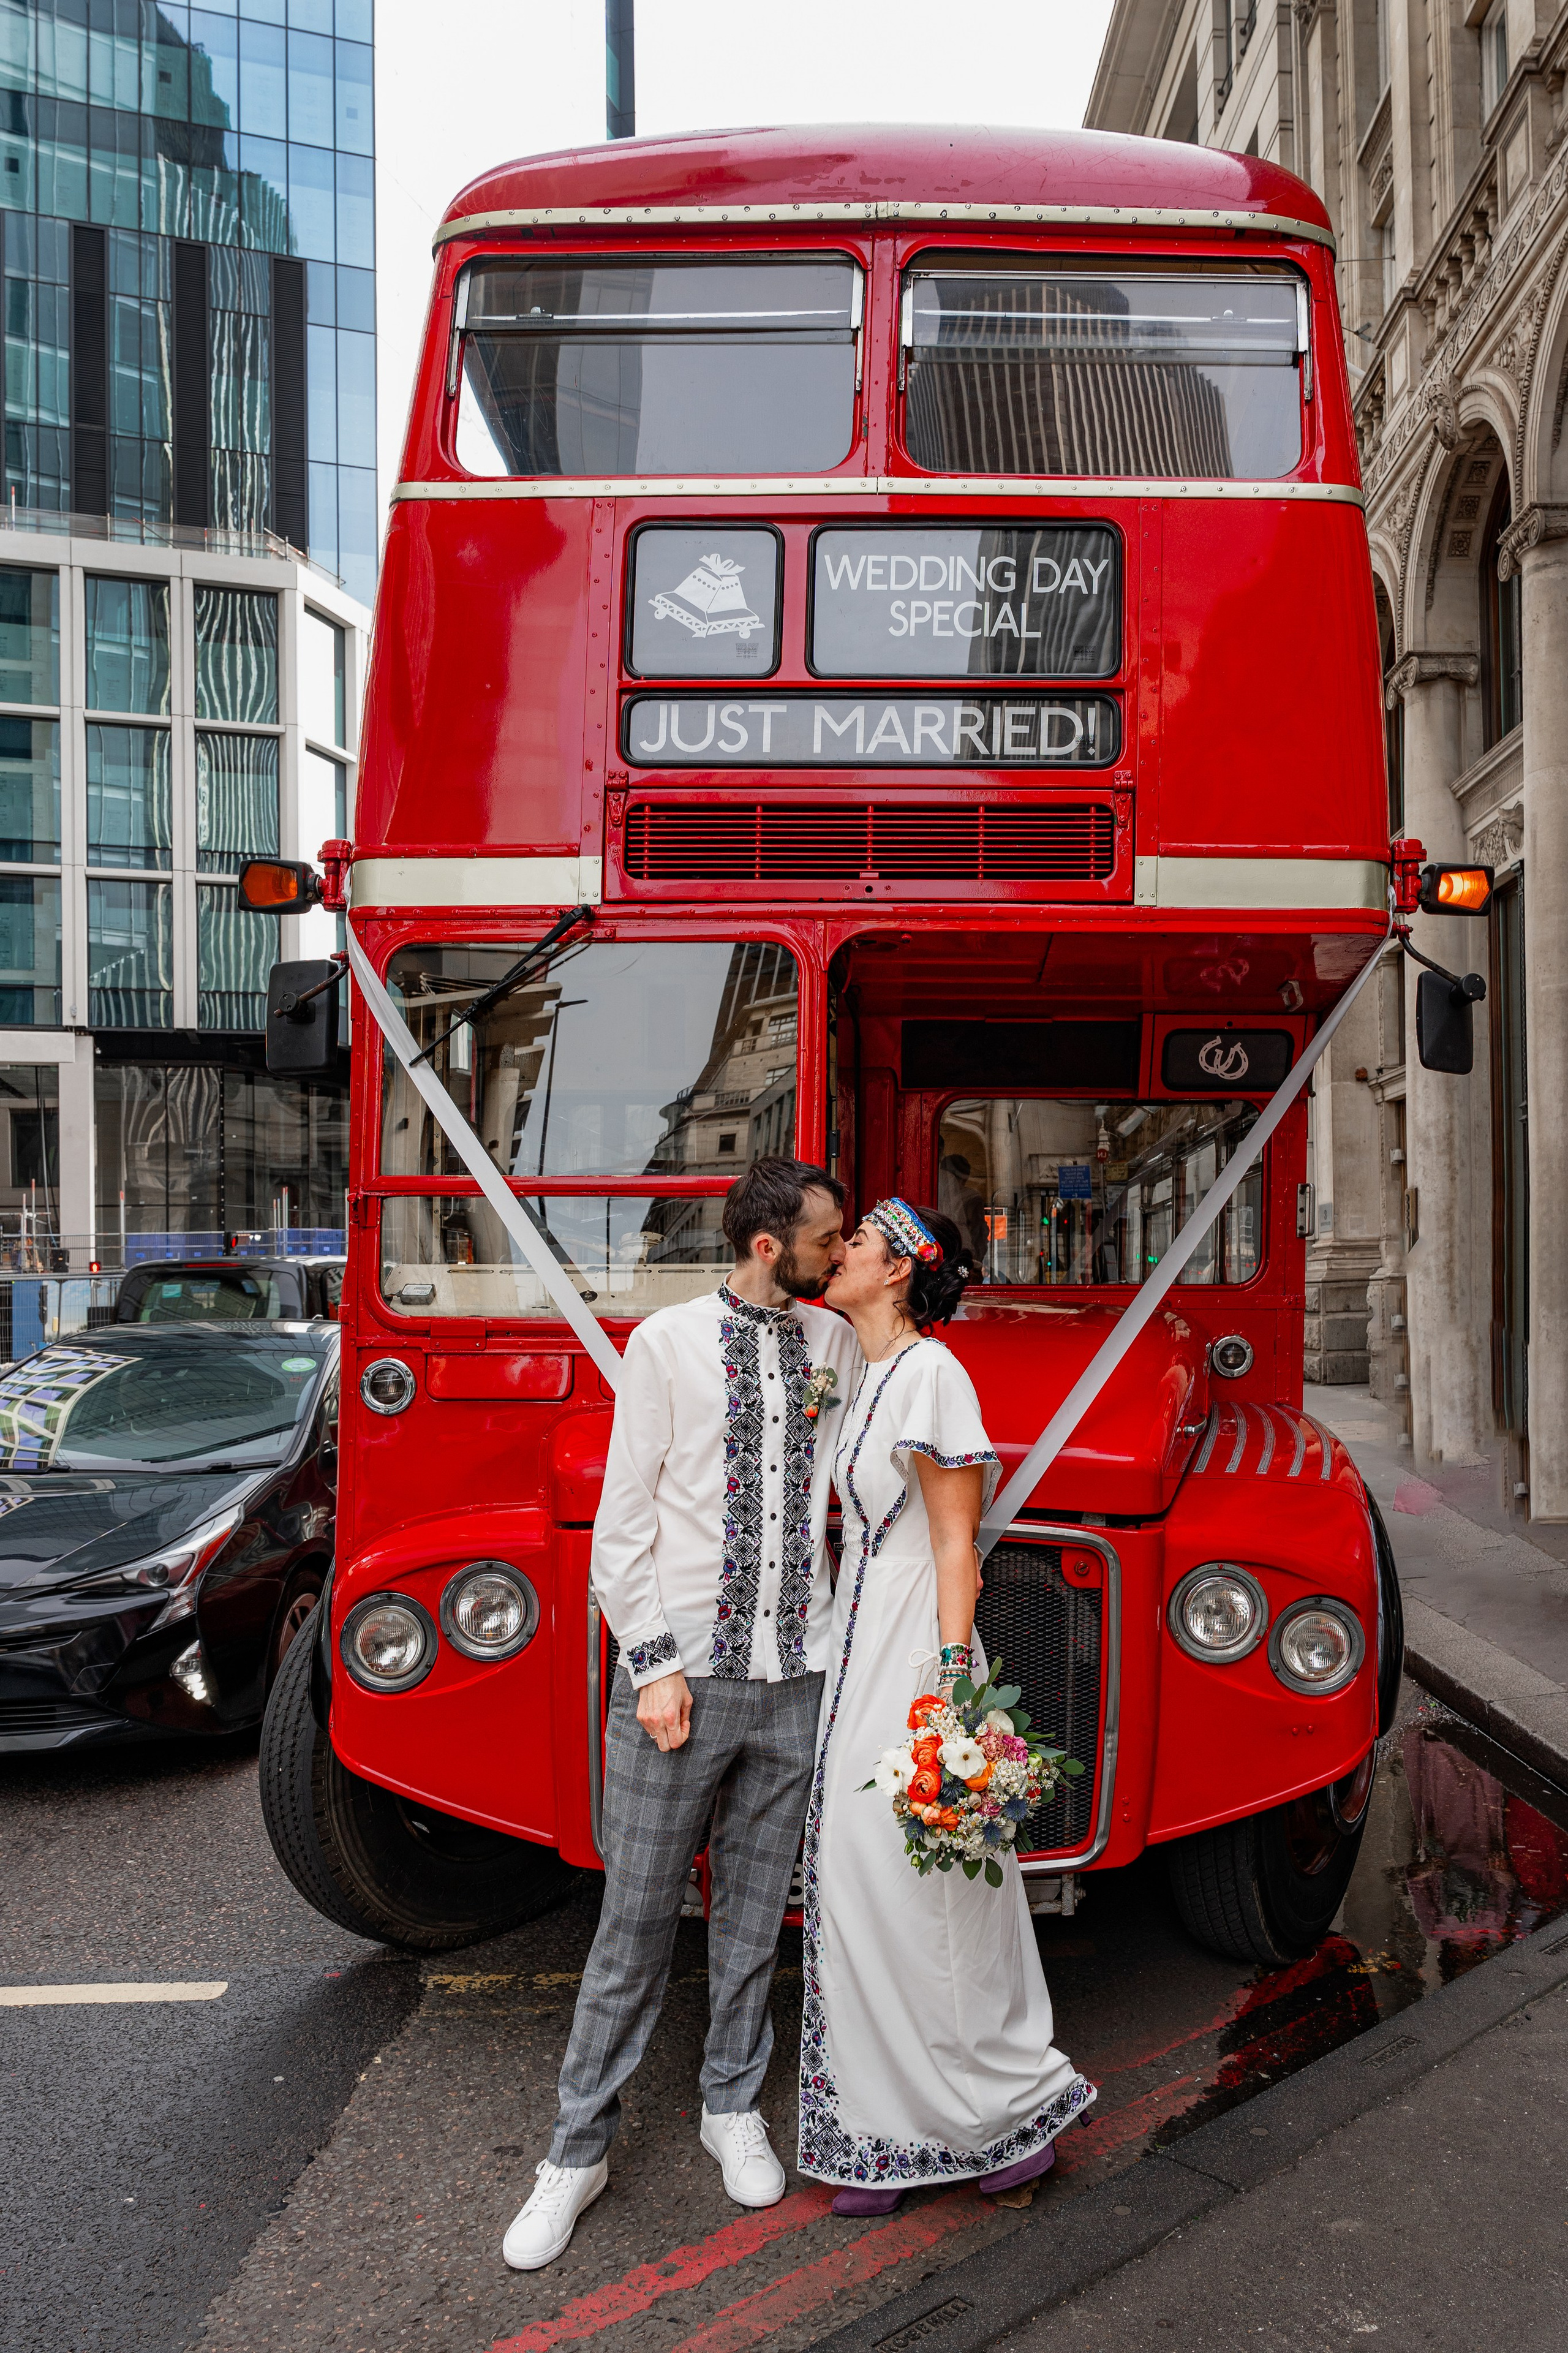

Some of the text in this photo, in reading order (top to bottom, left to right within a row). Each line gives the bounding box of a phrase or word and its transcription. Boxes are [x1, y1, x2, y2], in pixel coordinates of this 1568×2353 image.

[824, 554, 1109, 595] WEDDING DAY
[888, 600, 1042, 638] SPECIAL
[639, 704, 1096, 756] JUST MARRIED!
